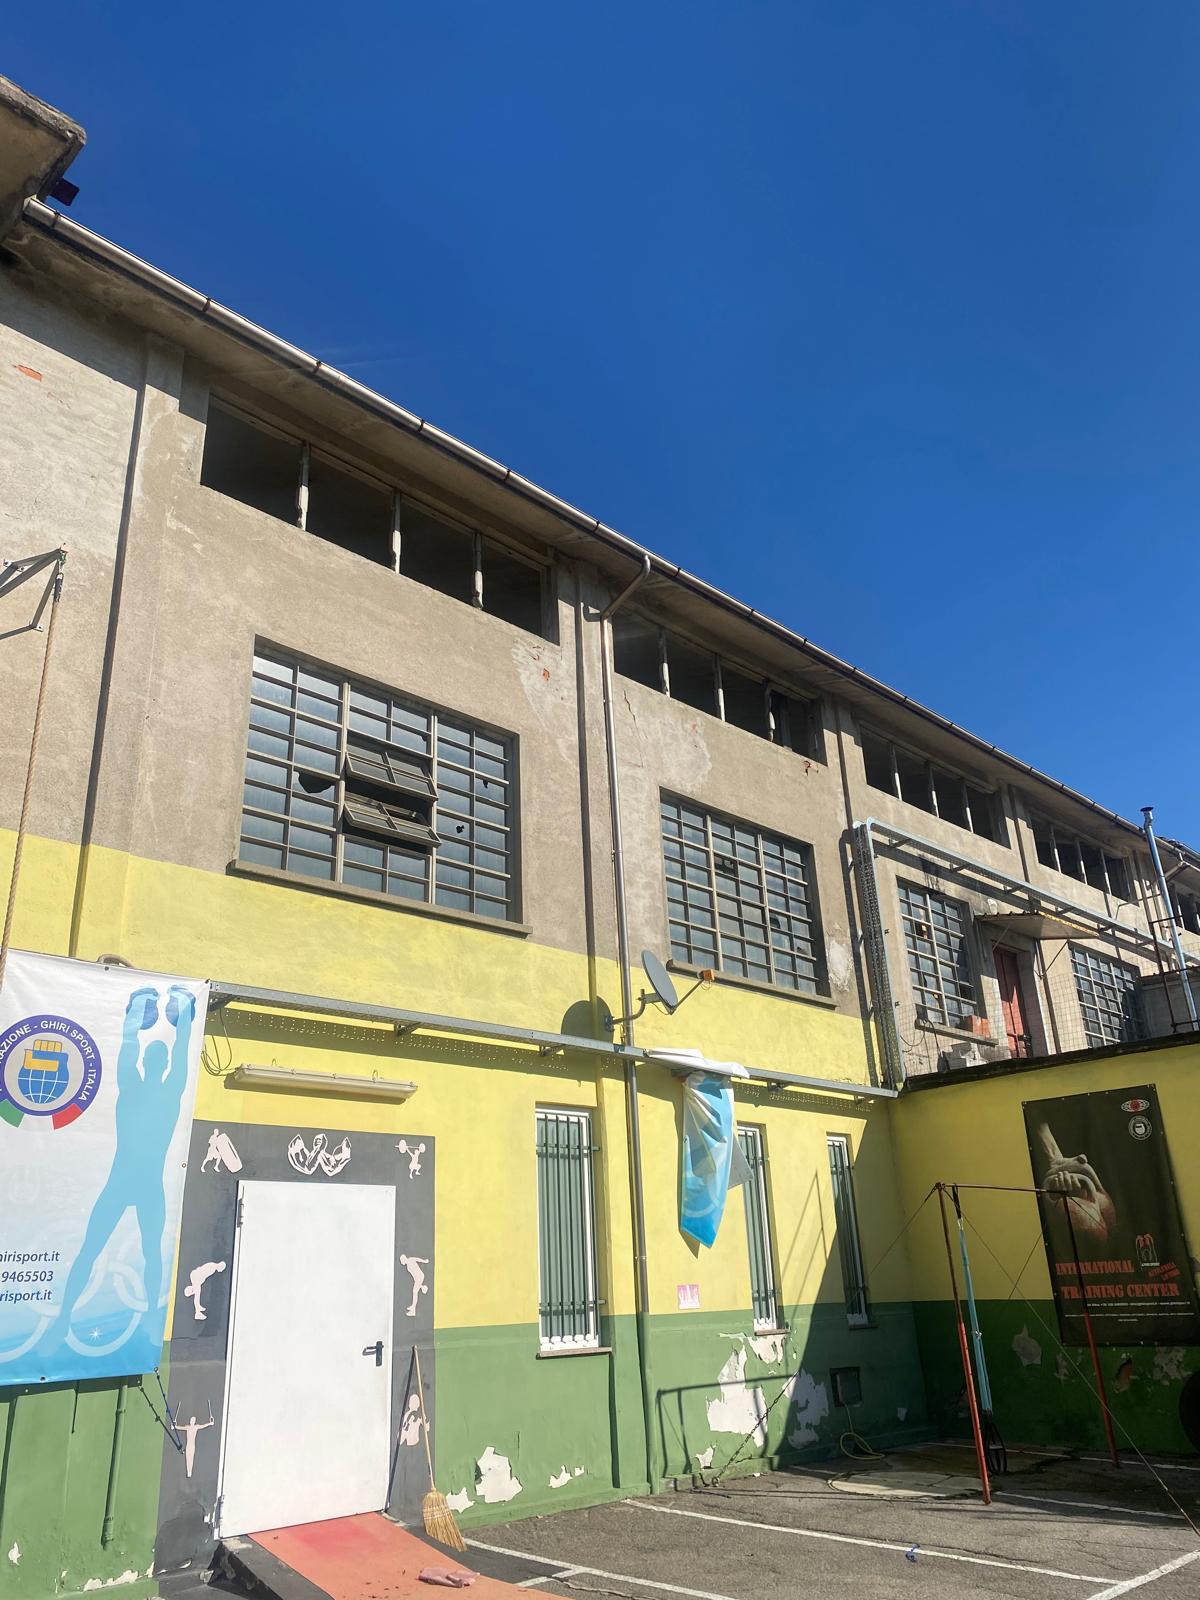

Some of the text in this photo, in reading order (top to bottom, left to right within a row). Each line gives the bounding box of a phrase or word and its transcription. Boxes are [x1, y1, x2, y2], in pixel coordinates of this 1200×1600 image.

[40, 1020, 70, 1033] GHIRI
[70, 1029, 95, 1061] SPORT
[79, 1069, 96, 1101] ITALIA
[1, 1270, 54, 1283] 9465503
[0, 1289, 52, 1304] risport.it
[1126, 1282, 1180, 1297] CENTER
